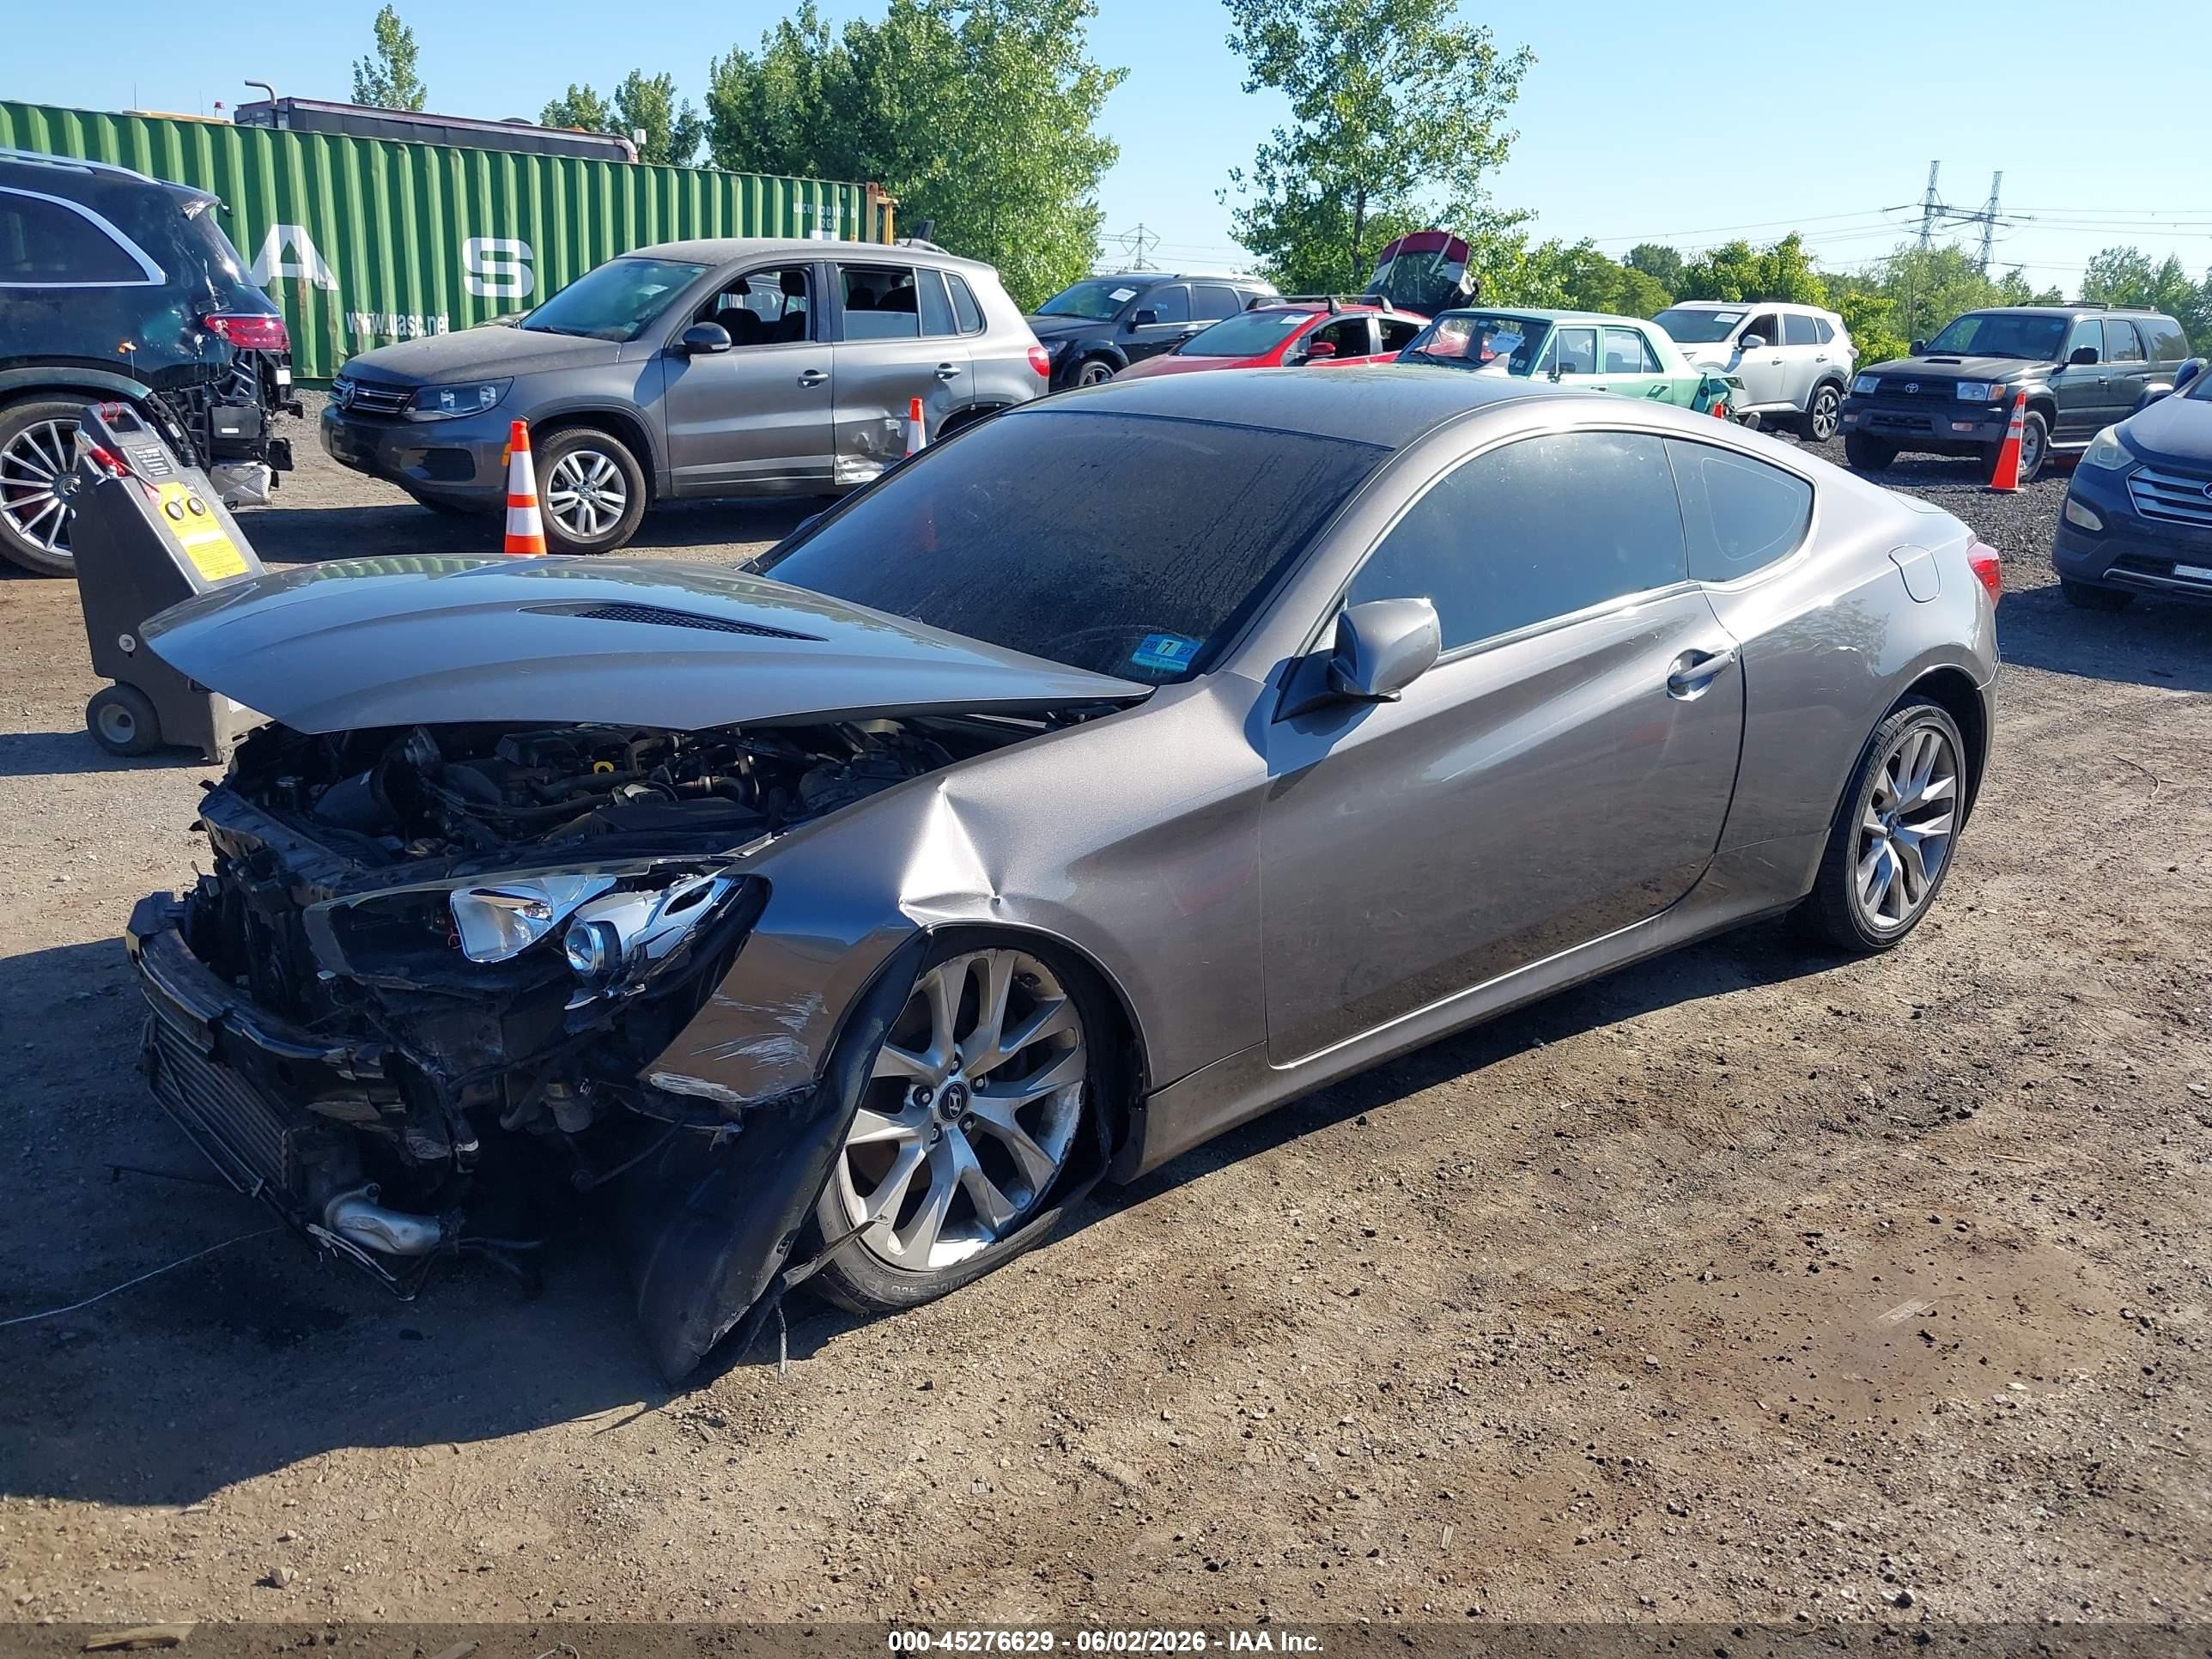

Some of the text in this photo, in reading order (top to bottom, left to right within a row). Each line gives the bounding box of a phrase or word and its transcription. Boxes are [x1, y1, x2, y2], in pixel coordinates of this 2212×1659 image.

[251, 223, 535, 299] A S
[345, 310, 451, 337] www.uasc.net
[1161, 641, 1175, 654] 7
[1178, 647, 1194, 655] 27
